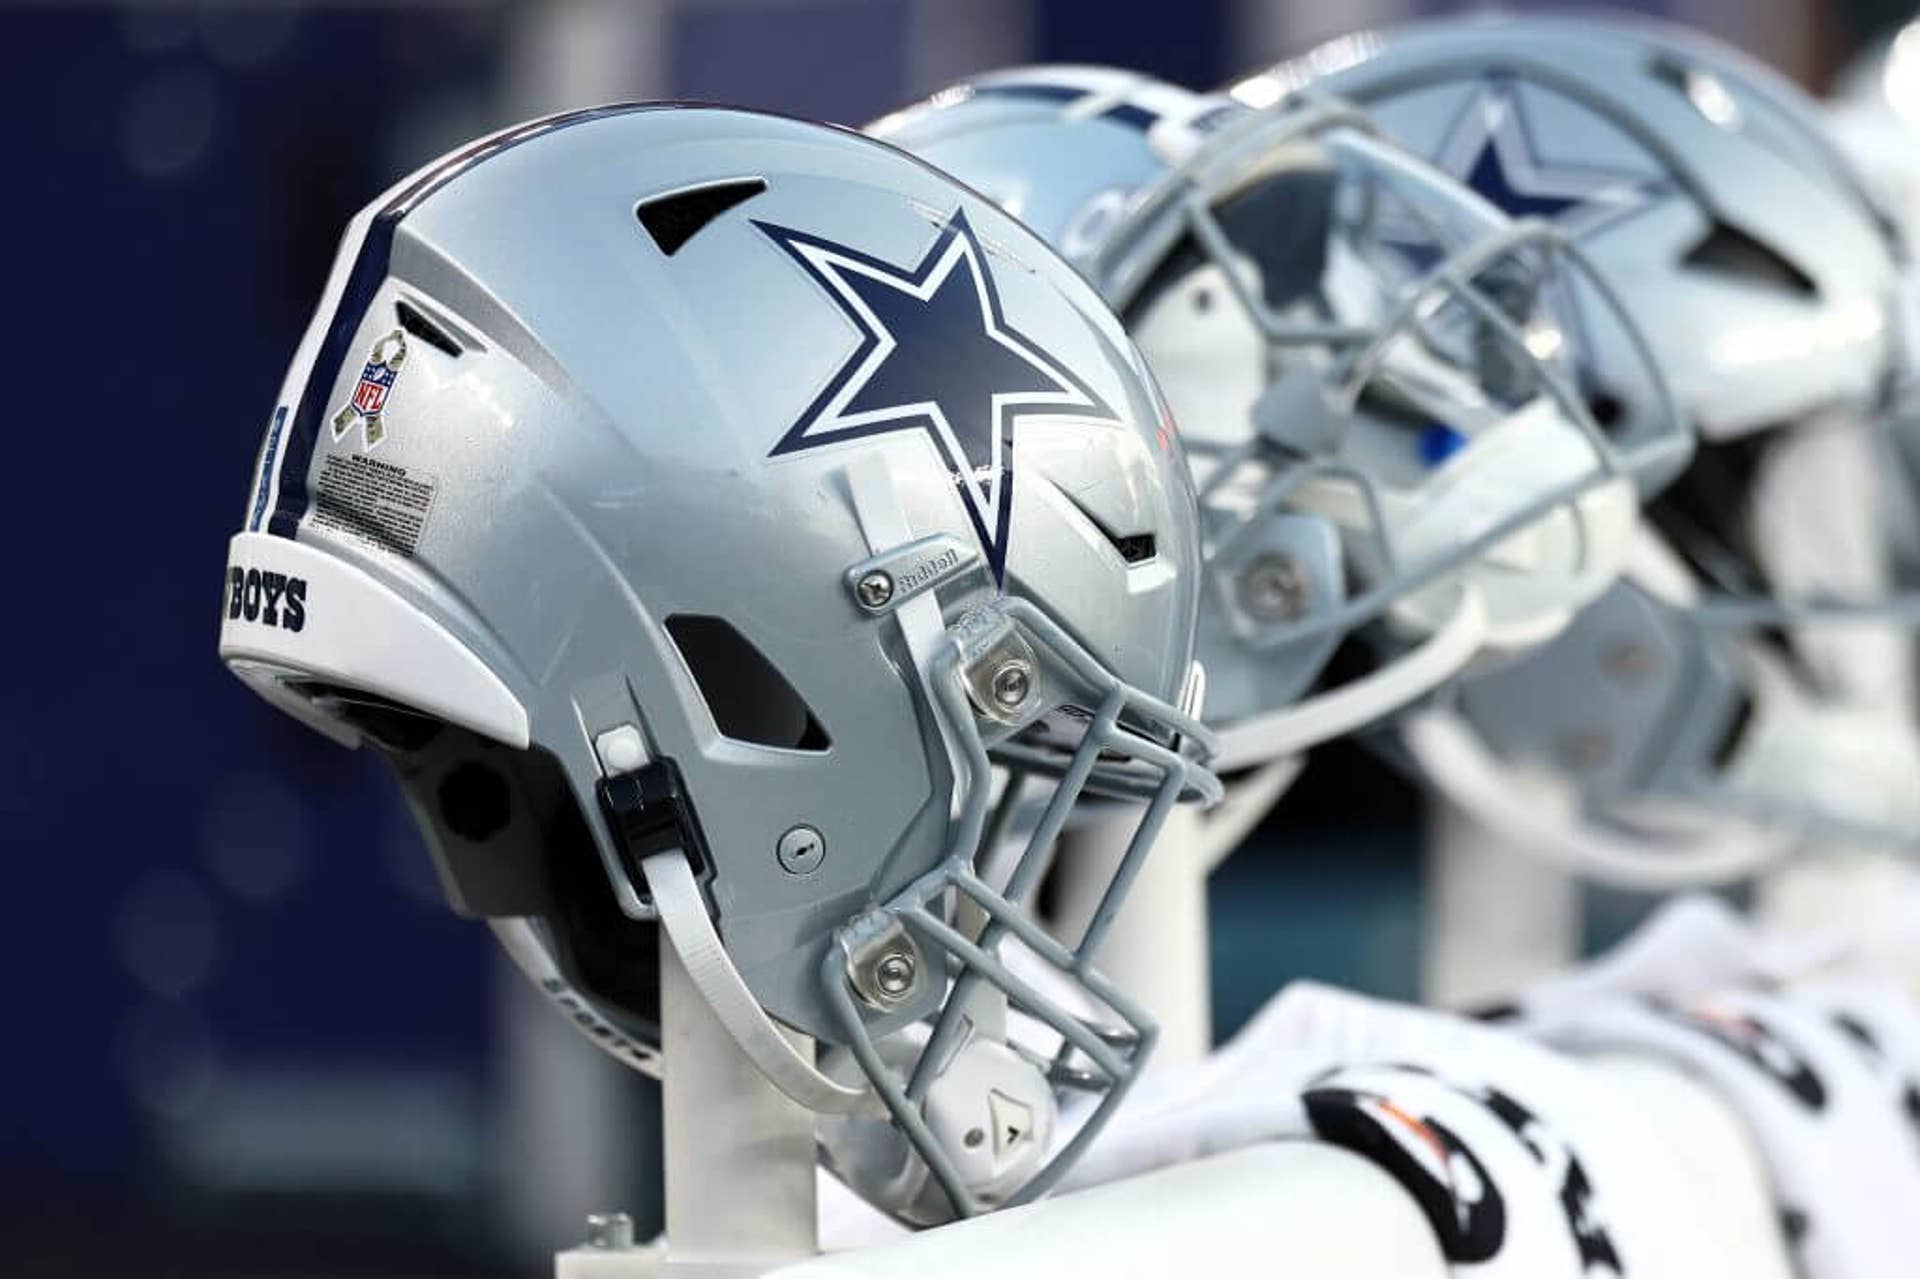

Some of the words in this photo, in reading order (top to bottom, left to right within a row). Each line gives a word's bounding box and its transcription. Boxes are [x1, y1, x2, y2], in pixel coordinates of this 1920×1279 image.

[354, 383, 387, 410] NFL
[352, 454, 407, 477] WARNING
[226, 566, 308, 633] BOYS
